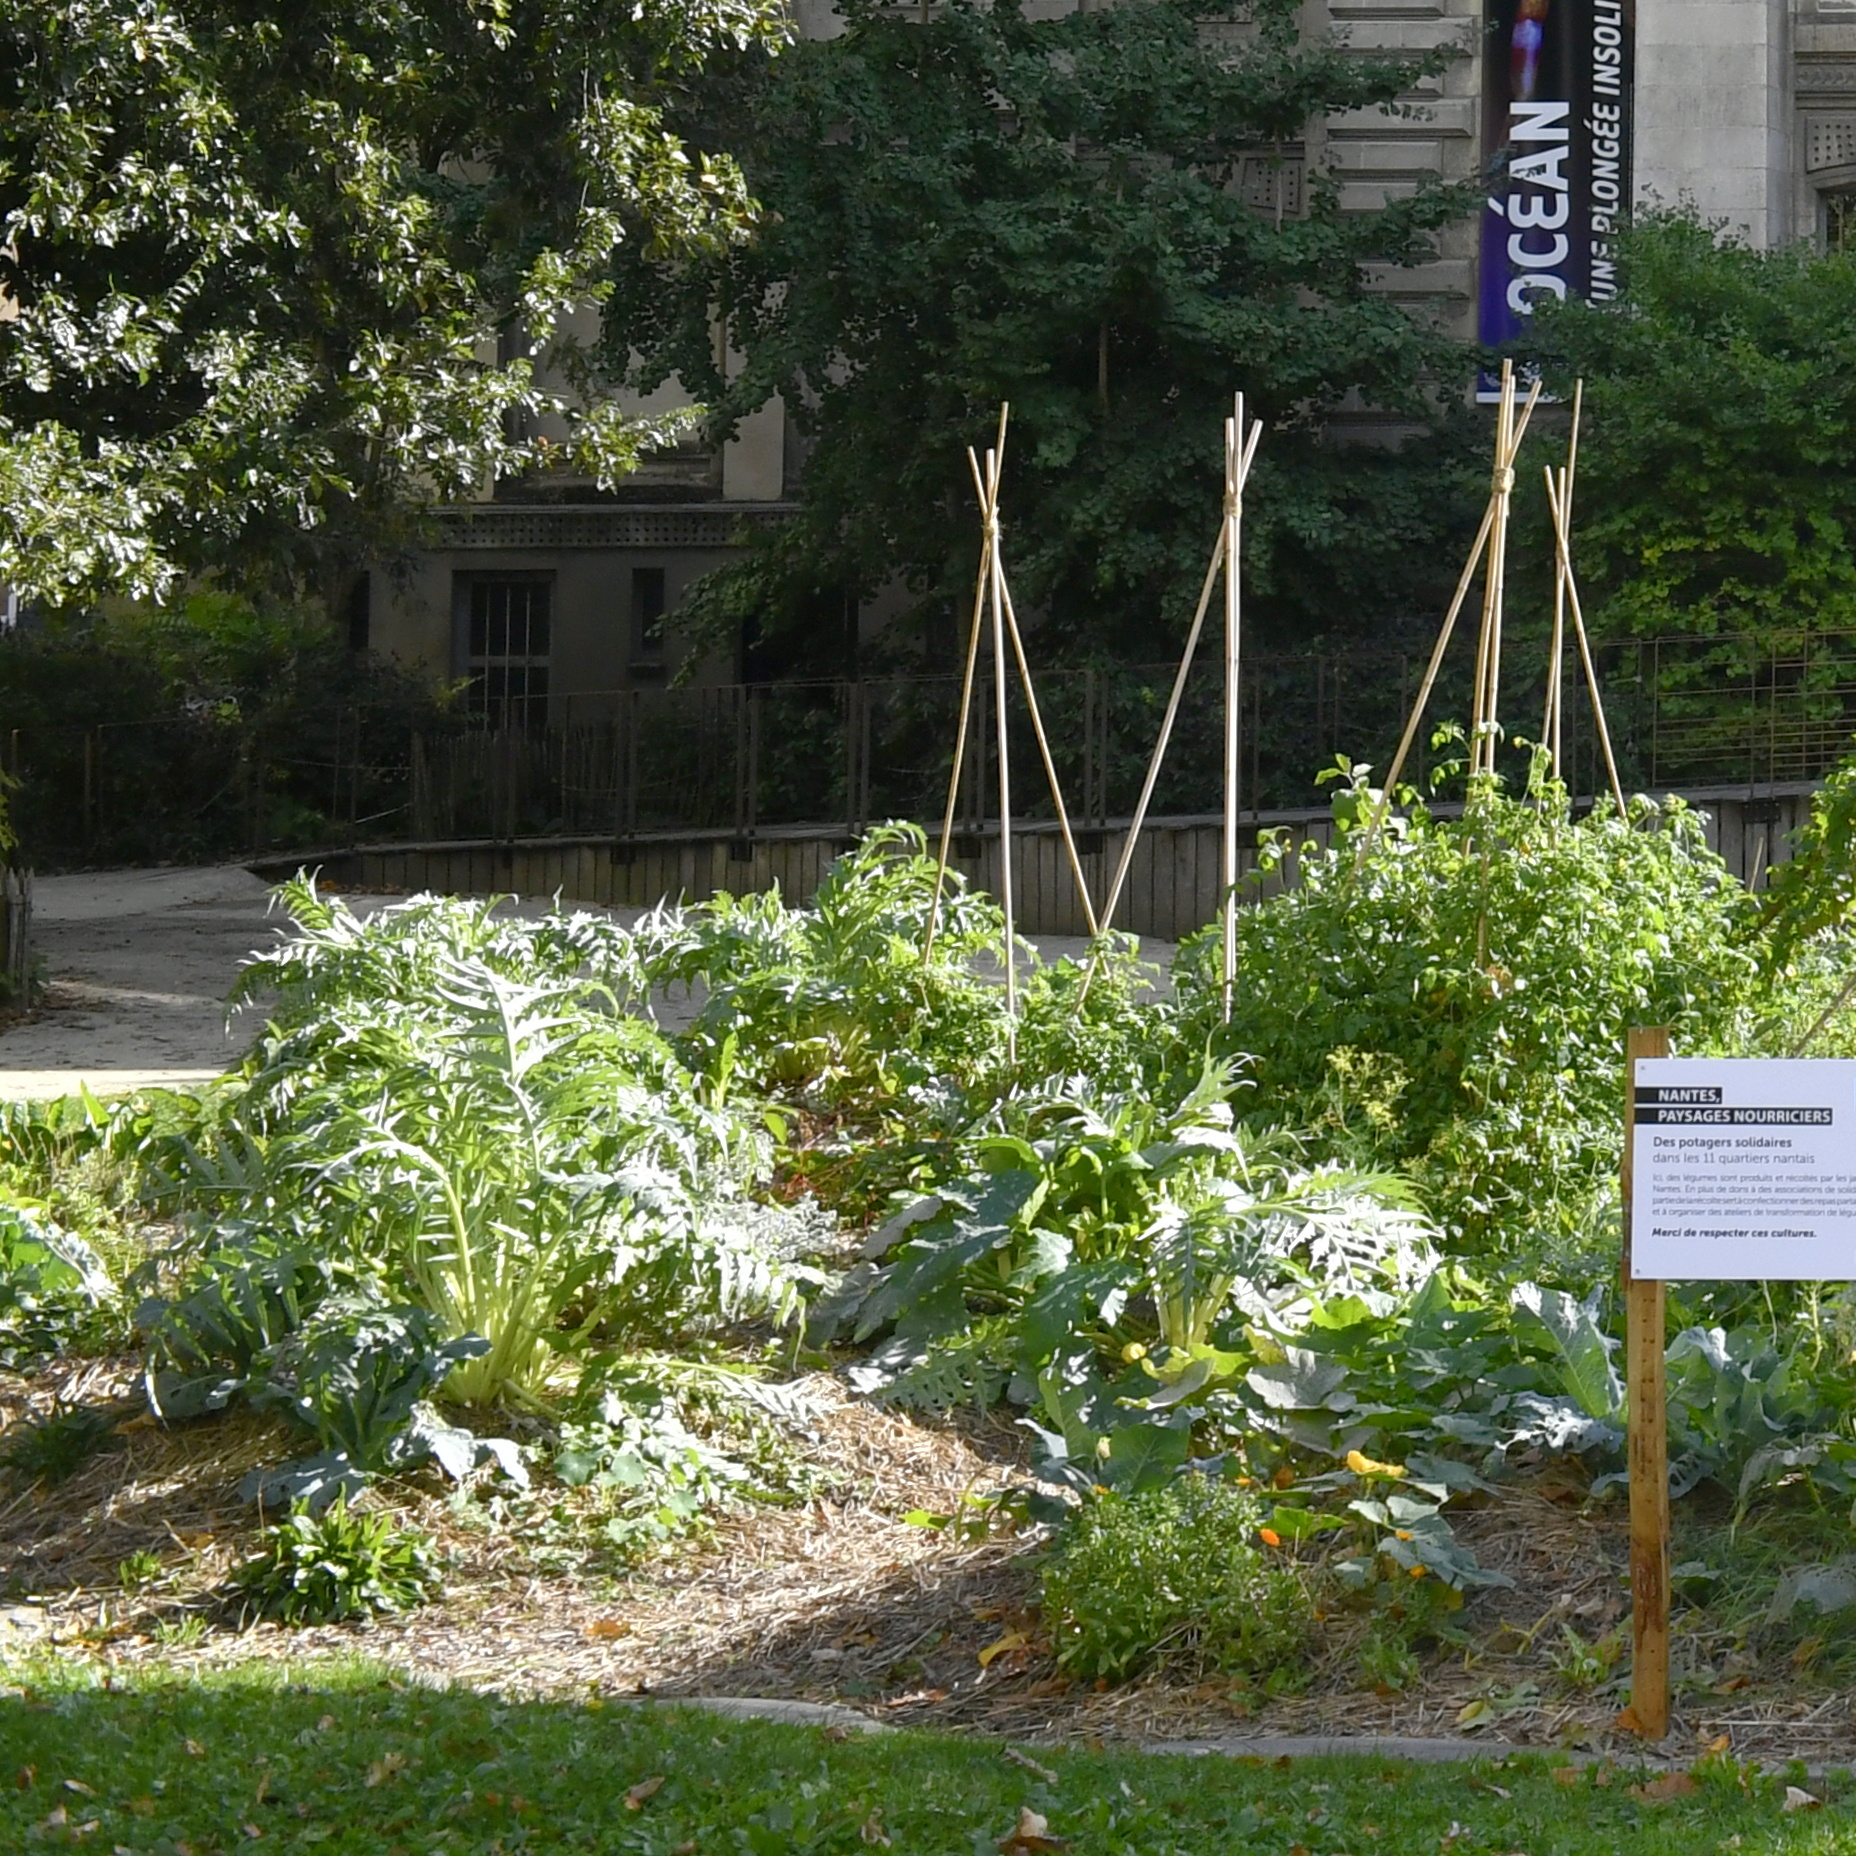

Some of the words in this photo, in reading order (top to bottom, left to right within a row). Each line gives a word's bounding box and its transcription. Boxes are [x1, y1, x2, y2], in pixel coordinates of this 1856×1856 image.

[1583, 103, 1621, 234] PLONGÉE
[1488, 101, 1569, 315] OCÉAN
[1657, 1089, 1720, 1103] NANTES,
[1657, 1110, 1731, 1123] PAYSAGES
[1734, 1110, 1831, 1123] NOURRICIERS
[1653, 1136, 1676, 1148] Des
[1679, 1136, 1732, 1150] potagers
[1735, 1136, 1792, 1148] solidaires
[1652, 1152, 1680, 1164] dans
[1683, 1152, 1699, 1164] les
[1703, 1153, 1716, 1163] 11
[1718, 1153, 1770, 1165] quartiers
[1773, 1153, 1815, 1164] nantais
[1666, 1174, 1681, 1182] des
[1820, 1176, 1833, 1185] par
[1684, 1185, 1695, 1193] En
[1716, 1185, 1727, 1193] de
[1758, 1185, 1772, 1193] des
[1824, 1186, 1835, 1194] de
[1707, 1208, 1722, 1216] des
[1651, 1227, 1682, 1237] Merci
[1684, 1228, 1697, 1237] de
[1699, 1228, 1749, 1240] respecter
[1751, 1229, 1768, 1237] ces
[1770, 1228, 1817, 1238] cultures.
